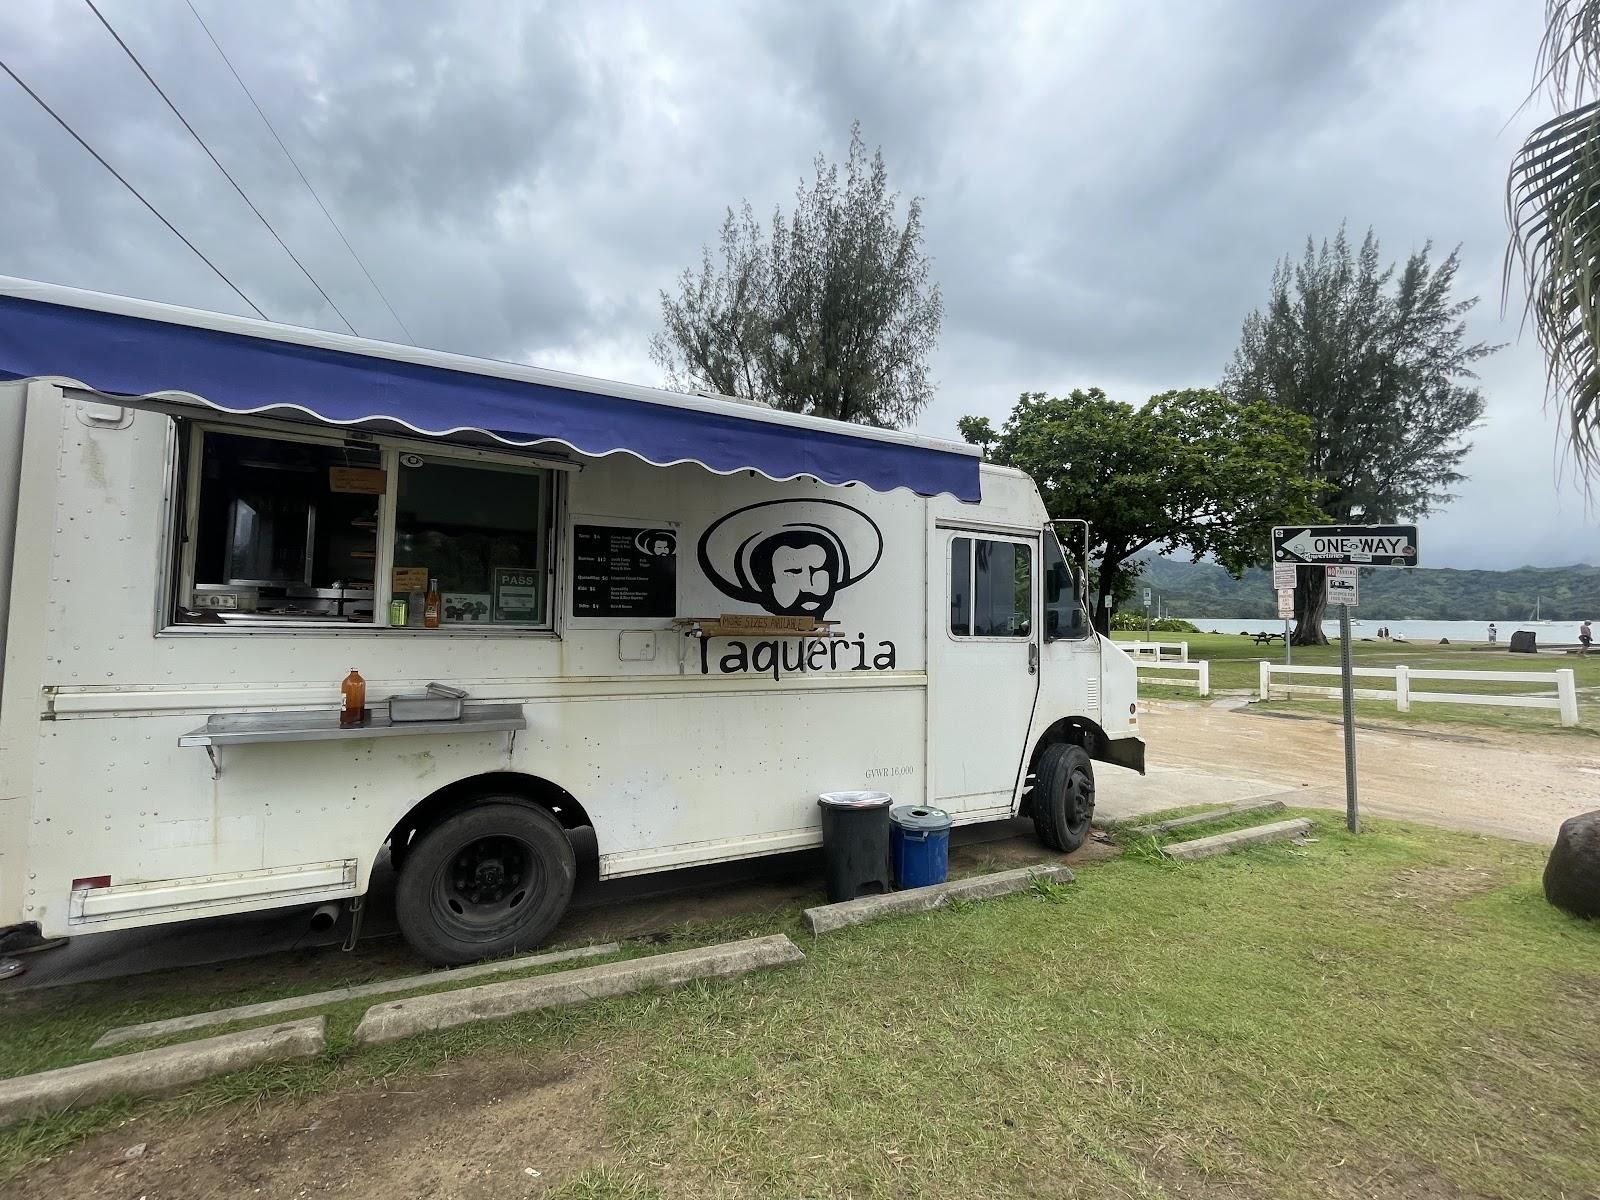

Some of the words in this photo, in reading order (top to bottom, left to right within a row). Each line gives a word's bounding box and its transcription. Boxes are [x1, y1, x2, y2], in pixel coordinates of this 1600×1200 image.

[1314, 538, 1351, 553] ONE
[1358, 538, 1401, 554] WAY
[1327, 567, 1337, 577] NO
[502, 575, 534, 585] PASS
[722, 616, 742, 627] MORE
[744, 617, 768, 628] SIZES
[865, 768, 889, 779] GVWR
